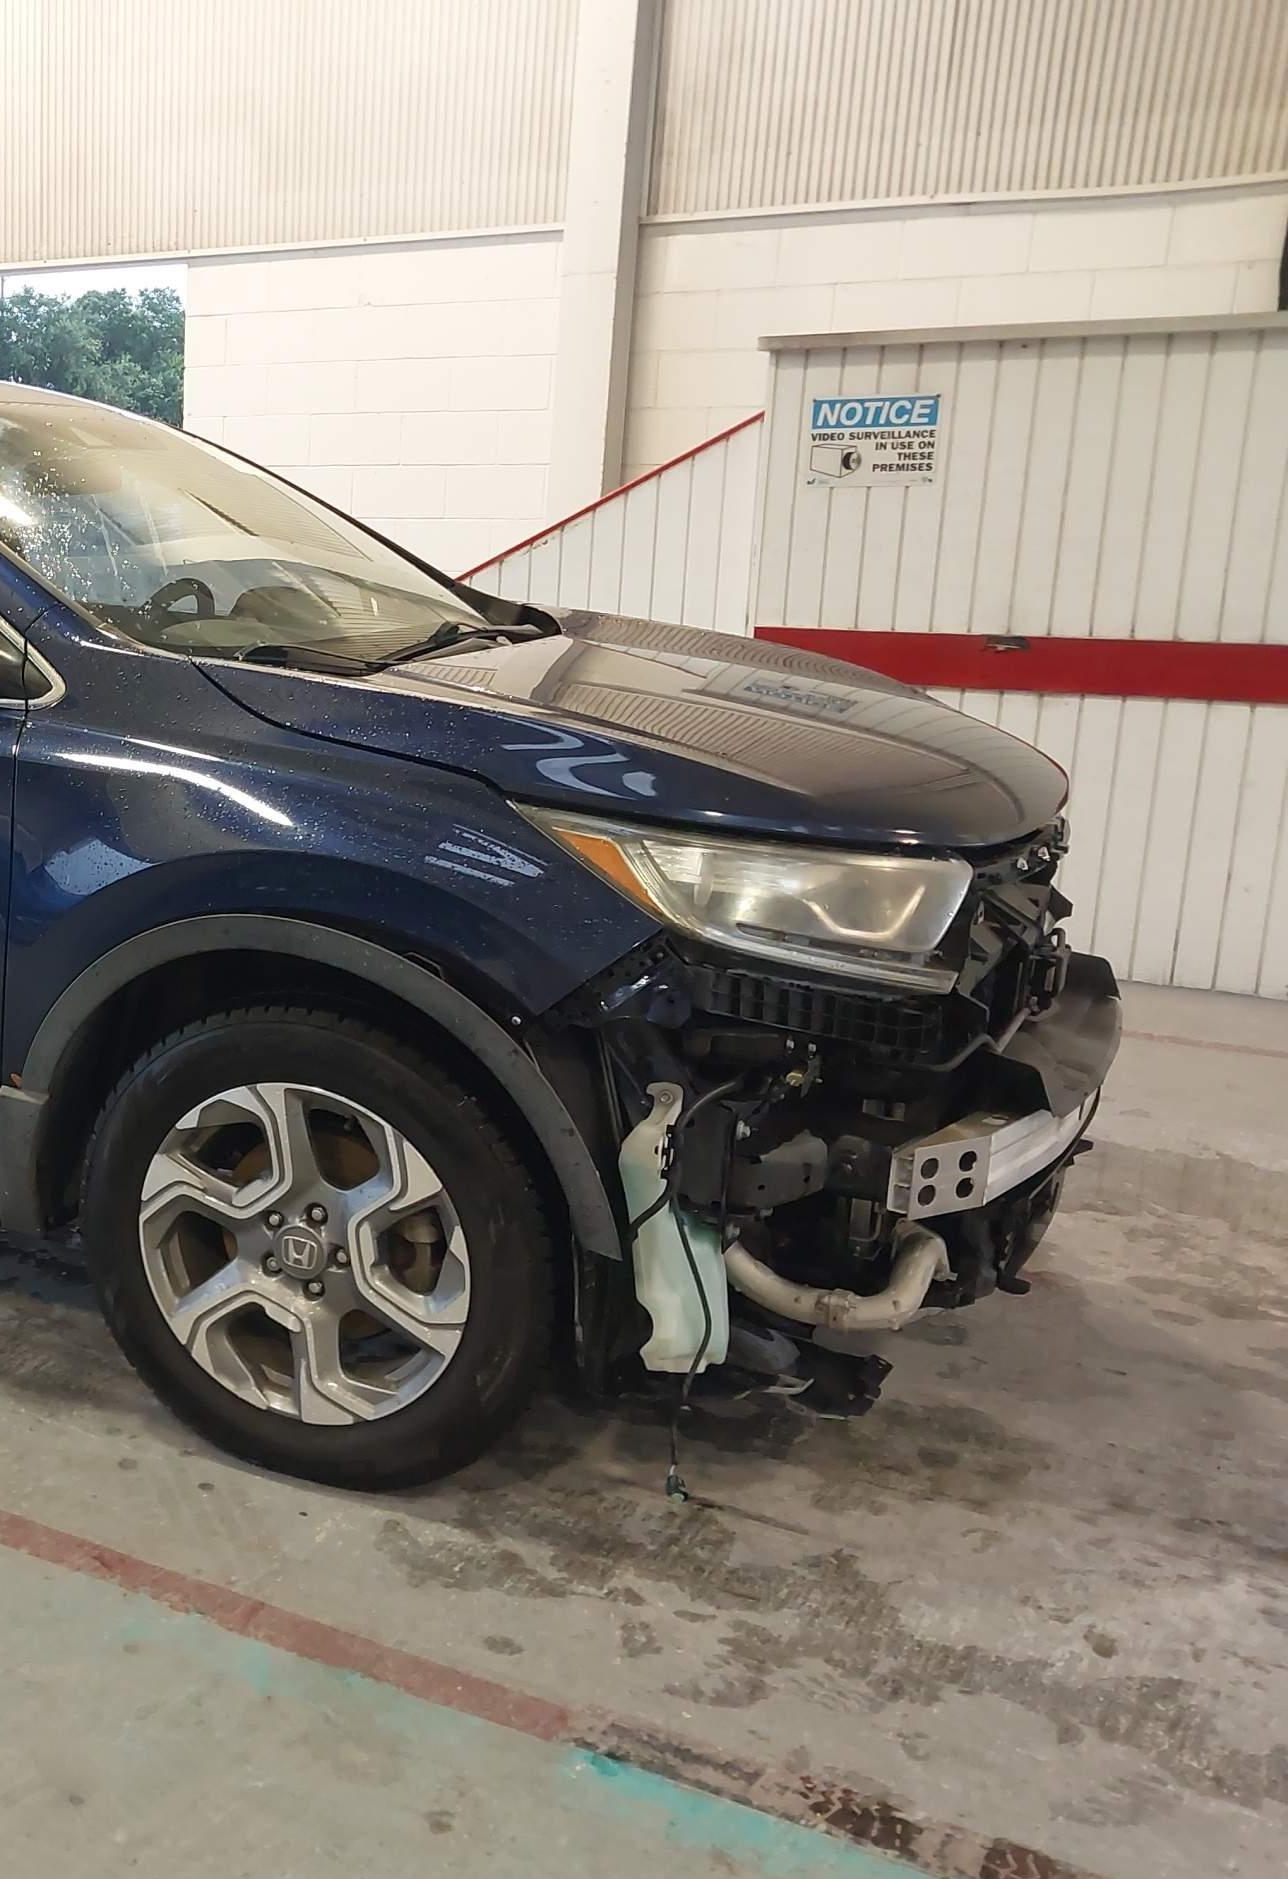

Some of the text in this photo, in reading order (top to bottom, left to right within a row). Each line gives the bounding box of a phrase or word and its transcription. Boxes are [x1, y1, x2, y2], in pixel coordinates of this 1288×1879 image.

[816, 399, 936, 427] NOTICE
[811, 429, 937, 442] VIDEO SURVEILLANCE
[875, 440, 936, 451] IN USE ON
[897, 451, 935, 461] THESE
[872, 462, 933, 473] PREMISES
